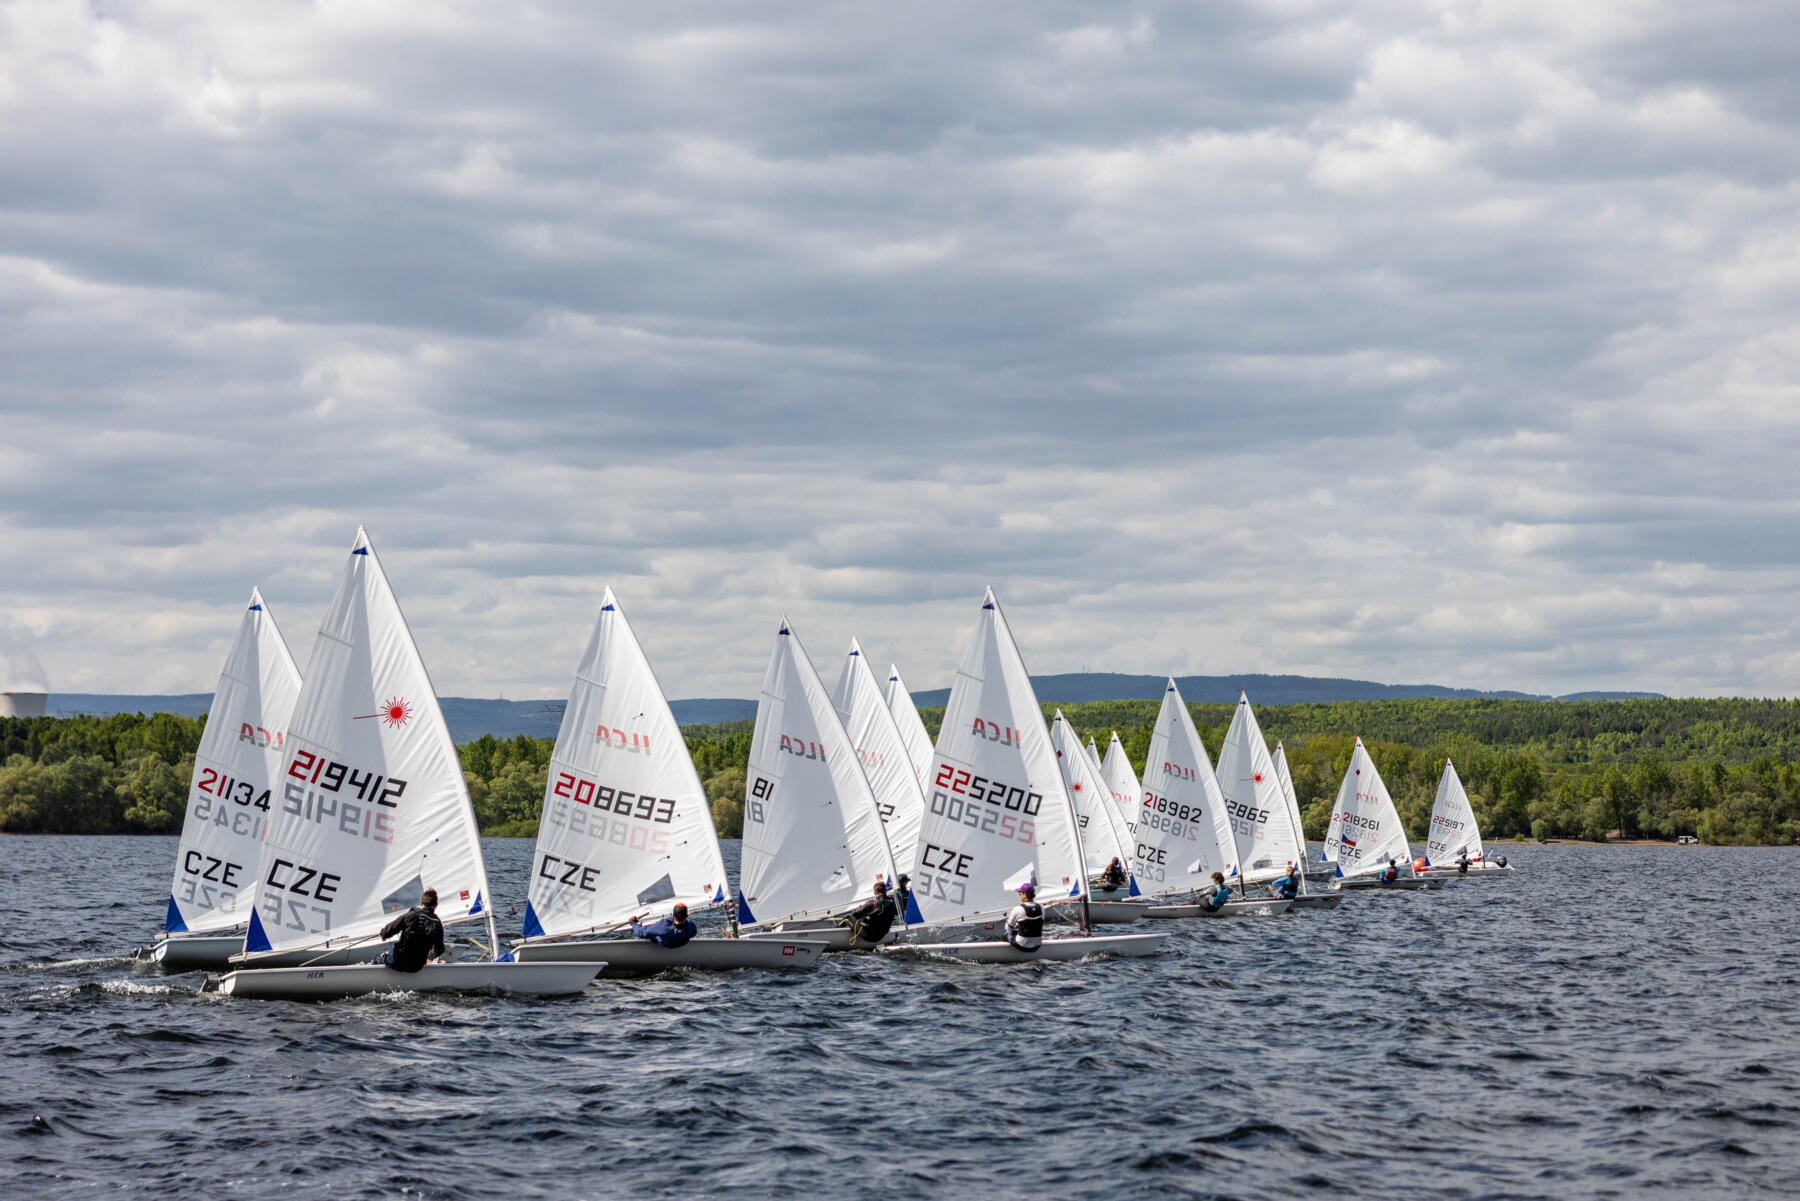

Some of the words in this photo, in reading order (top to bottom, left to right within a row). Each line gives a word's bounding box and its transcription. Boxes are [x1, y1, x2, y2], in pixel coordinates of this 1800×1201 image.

[198, 768, 271, 812] 21134
[288, 750, 407, 808] 219412
[936, 764, 1043, 816] 225200
[553, 772, 676, 823] 208693
[1144, 792, 1202, 823] 218982
[1343, 812, 1380, 830] 218261
[1433, 815, 1464, 831] 225197
[1137, 844, 1167, 865] CZE
[1328, 838, 1339, 848] CZ
[1340, 845, 1362, 859] CZE
[1429, 841, 1446, 852] CZE
[184, 850, 242, 888] CZE
[540, 855, 600, 892] CZE
[922, 844, 974, 878] CZE
[267, 858, 341, 902] CZE
